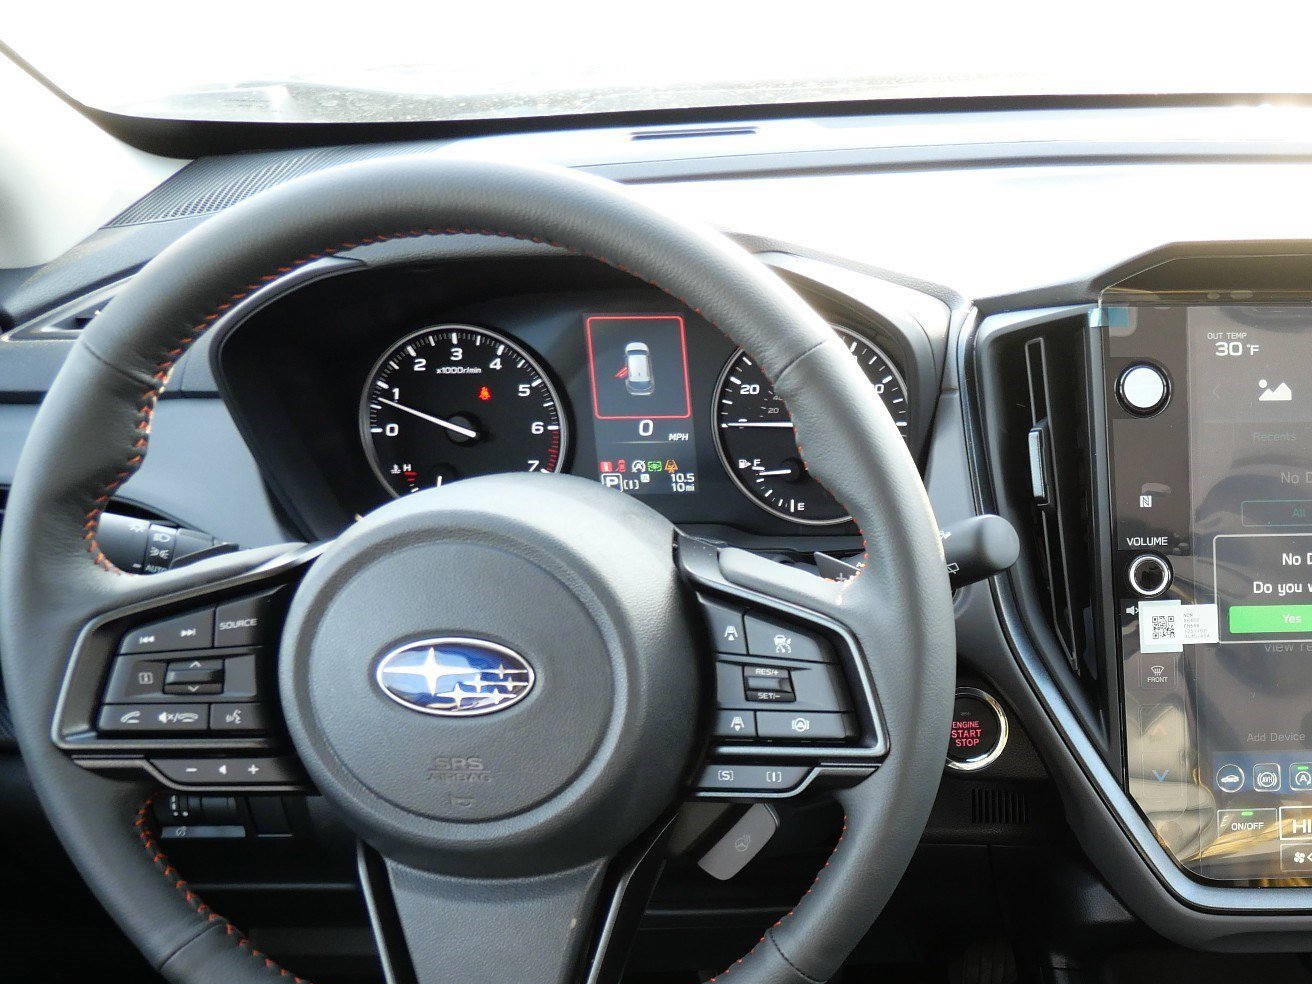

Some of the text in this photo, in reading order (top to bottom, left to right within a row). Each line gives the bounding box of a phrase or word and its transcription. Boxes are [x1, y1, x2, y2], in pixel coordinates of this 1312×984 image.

[1207, 332, 1247, 340] OUT TEMP
[450, 347, 463, 360] 3
[1215, 341, 1243, 356] 30
[413, 358, 426, 371] 2
[489, 357, 502, 370] 4
[392, 387, 400, 402] 1
[518, 384, 531, 397] 5
[740, 384, 760, 395] 20
[385, 423, 399, 437] 0
[531, 421, 544, 434] 6
[638, 419, 654, 437] 0
[668, 433, 689, 441] MPH
[1253, 431, 1297, 442] Recents
[527, 460, 540, 472] 7
[753, 459, 761, 467] F
[670, 473, 695, 483] 10.5
[1281, 472, 1300, 484] No
[1292, 507, 1306, 518] All
[1126, 536, 1168, 546] VOLUME
[1282, 552, 1301, 566] No
[1253, 581, 1273, 594] Do
[1278, 582, 1303, 596] you
[219, 617, 258, 630] SOURCE
[1282, 614, 1302, 624] Yes
[952, 720, 980, 729] ENGINE
[951, 729, 982, 738] START
[1247, 731, 1306, 742] Add Device
[955, 738, 980, 747] STOP
[1231, 822, 1264, 831] ON/OFF
[1292, 819, 1312, 834] HI
